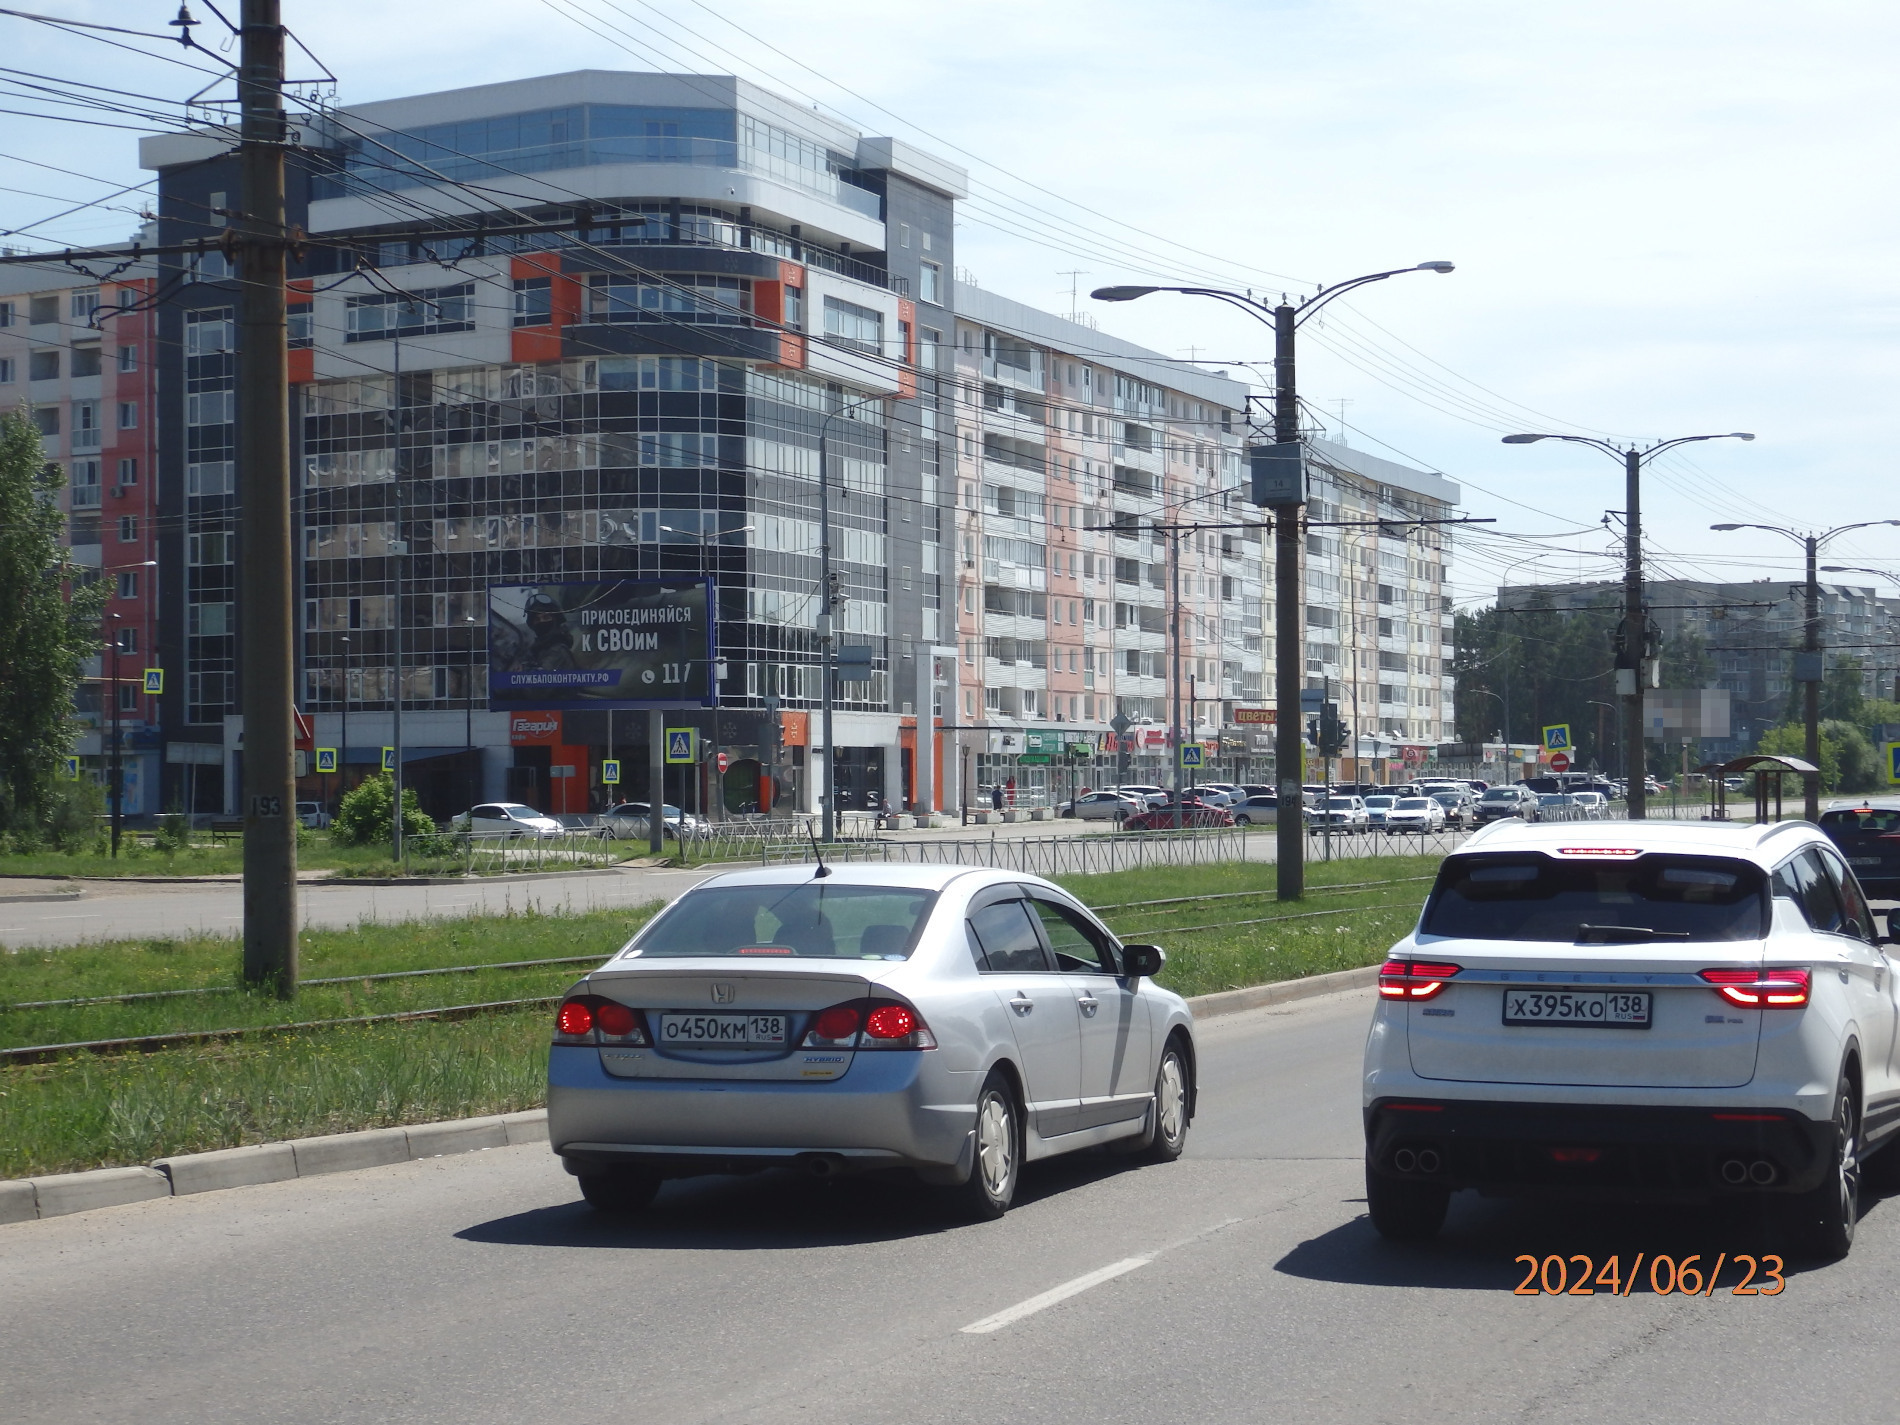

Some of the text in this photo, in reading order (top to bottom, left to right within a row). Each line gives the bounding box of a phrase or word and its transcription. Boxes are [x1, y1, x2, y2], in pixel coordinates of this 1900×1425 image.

[581, 605, 692, 626] ПРИСОЕДИНЯЙСЯ
[511, 673, 609, 685] СЛУЖБАПОКОНТРАКТУ.РФ
[513, 718, 558, 735] Гагарин
[252, 796, 281, 816] 193
[1501, 972, 1653, 983] GEELY
[1609, 995, 1642, 1013] 138
[1615, 1012, 1632, 1020] RUS
[750, 1017, 780, 1034] 138
